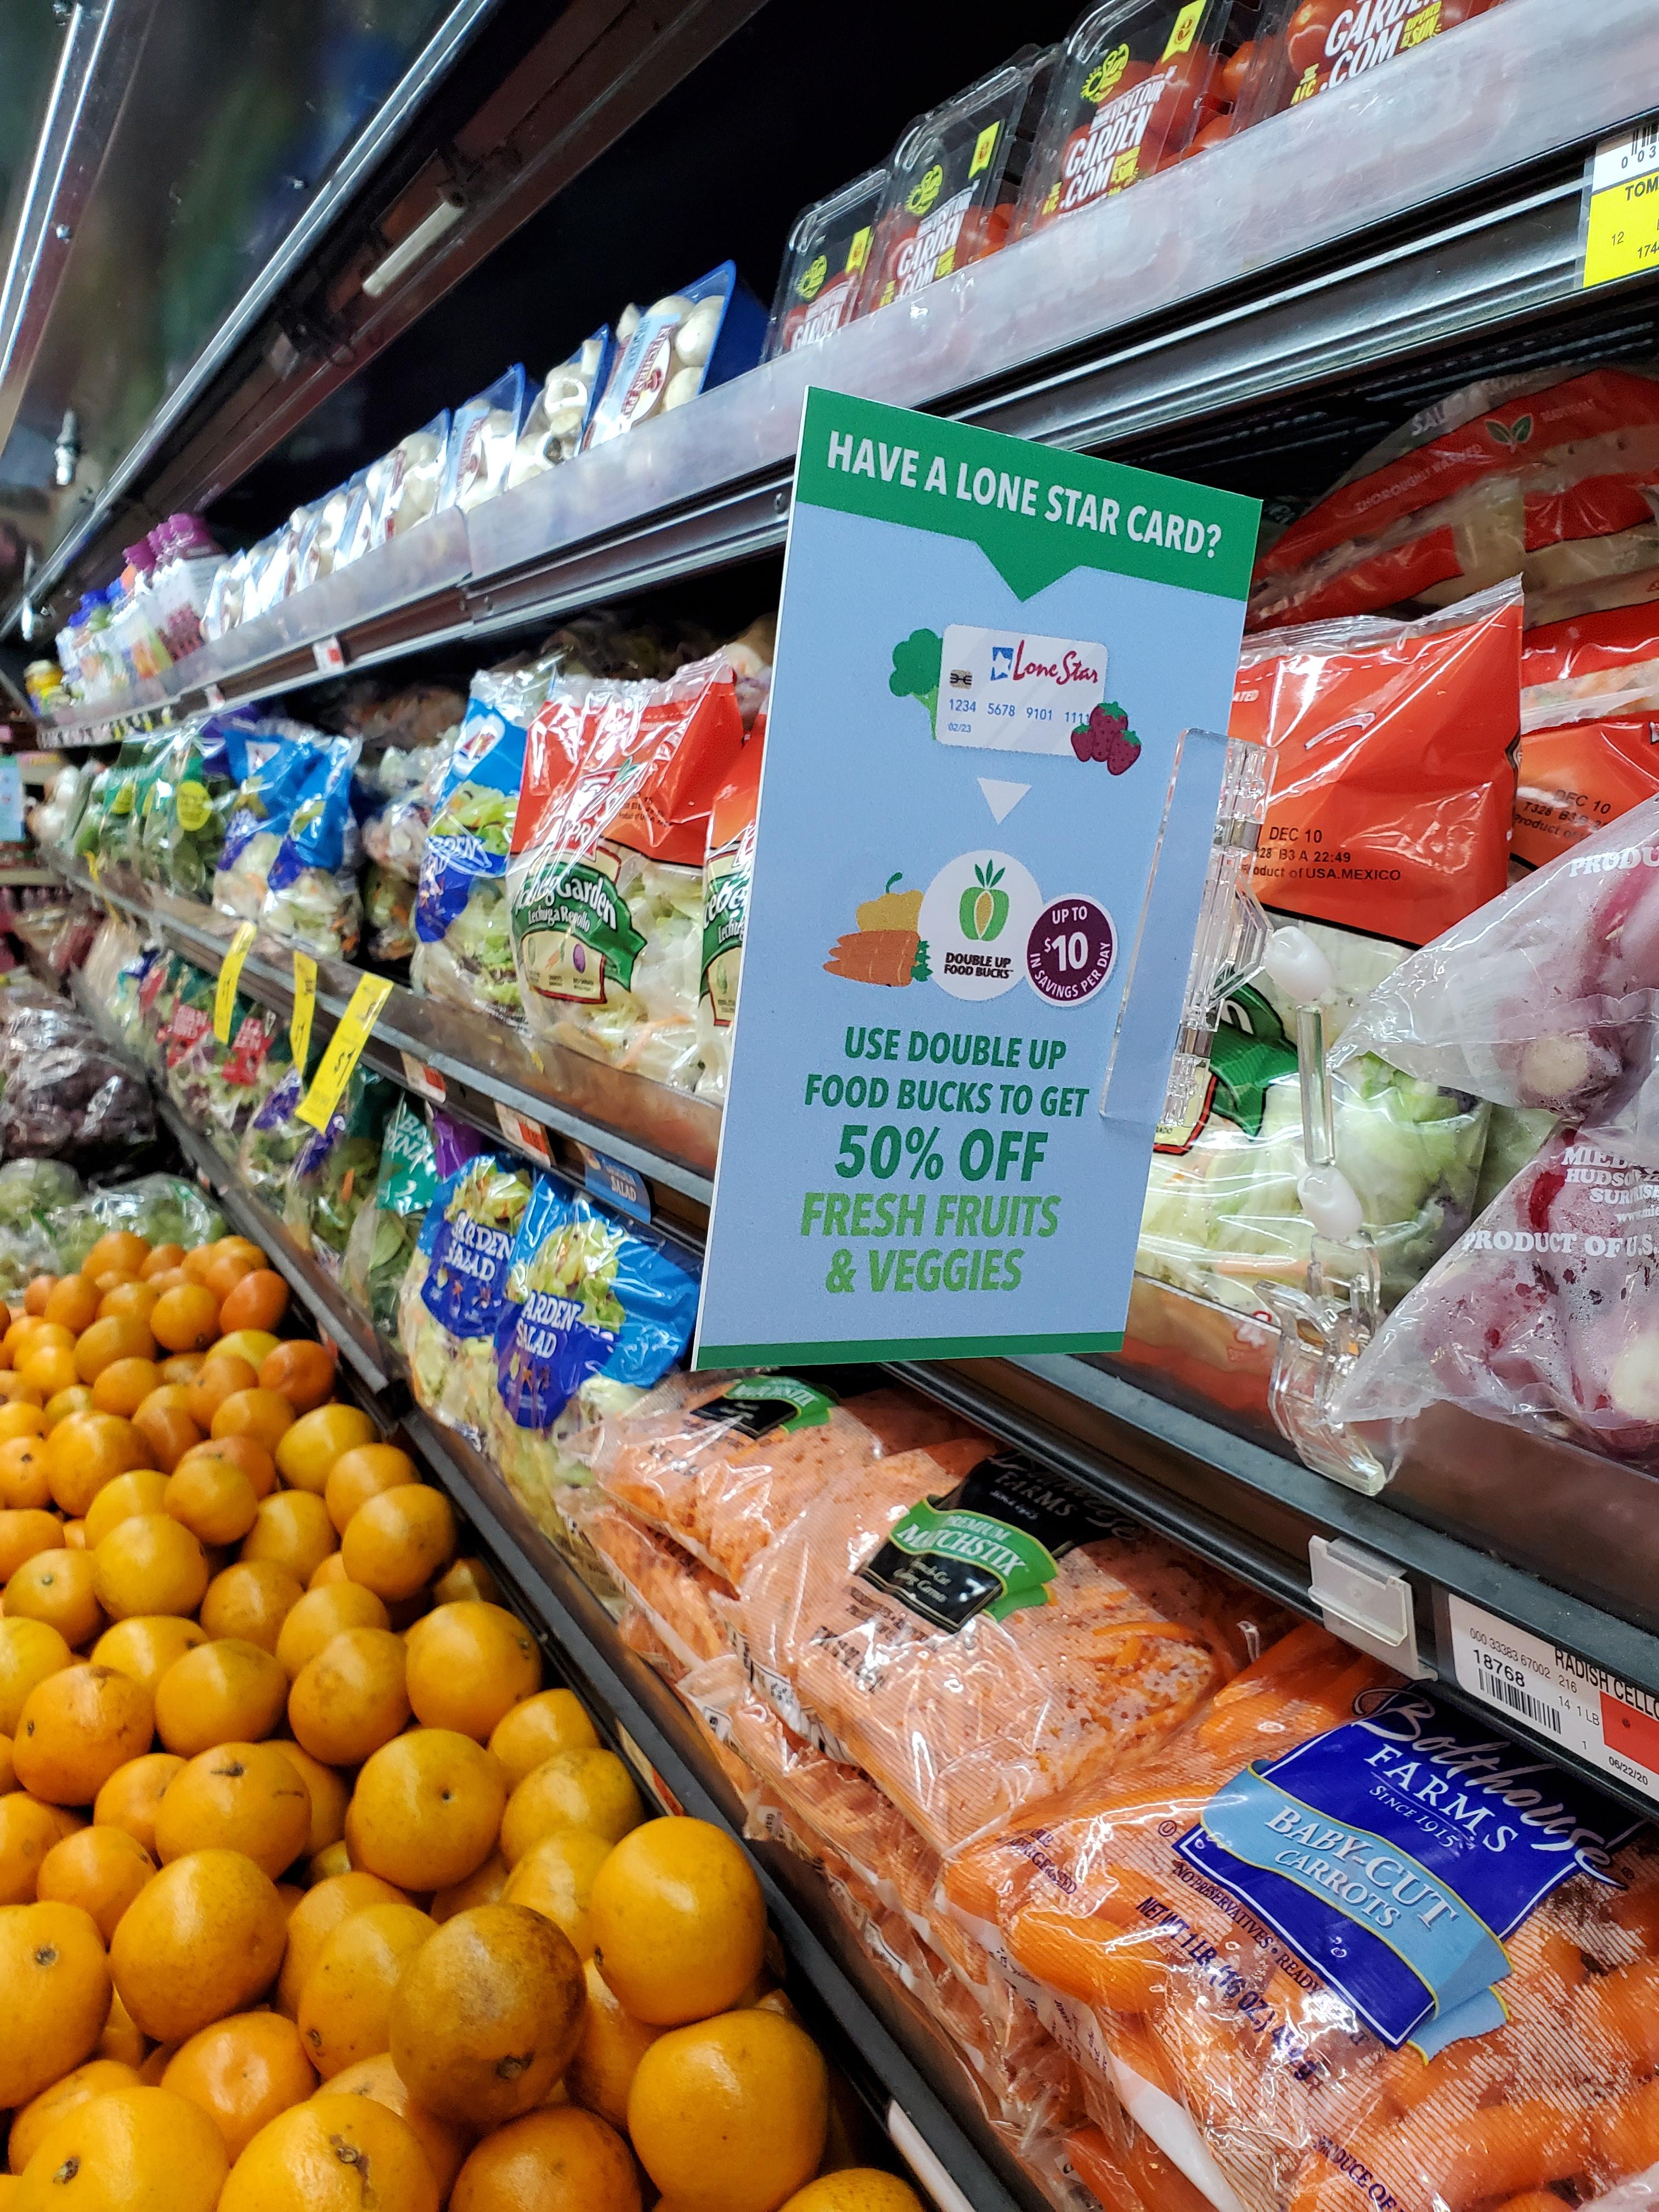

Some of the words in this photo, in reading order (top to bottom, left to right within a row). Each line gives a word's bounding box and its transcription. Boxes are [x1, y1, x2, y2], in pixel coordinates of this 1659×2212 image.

[1324, 0, 1438, 57] GARD
[1065, 103, 1155, 178] GARDEN
[1624, 177, 1659, 201] TOM
[1611, 231, 1624, 246] 12
[1637, 241, 1659, 259] 174
[827, 430, 919, 489] HAVE
[924, 456, 947, 496] A
[956, 462, 1040, 517] LONE
[1045, 484, 1121, 536] STAR
[1126, 505, 1222, 558] CARD?
[948, 723, 972, 733] 02/23
[949, 698, 977, 713] 1234
[988, 703, 1015, 717] 5678
[1026, 707, 1053, 721] 9101
[1593, 800, 1612, 815] 10
[1269, 826, 1299, 842] DEC
[1305, 829, 1323, 844] 10
[1255, 847, 1272, 859] 328
[1279, 848, 1295, 861] B3
[1299, 849, 1308, 862] A
[1313, 851, 1351, 864] 22:49
[1289, 866, 1303, 879] of
[528, 904, 560, 927] Lechuga
[557, 877, 617, 930] Garden
[1052, 909, 1069, 924] UP
[1071, 906, 1088, 921] TO
[944, 964, 973, 975] FOOD
[975, 967, 1010, 979] BUCKS
[945, 952, 992, 968] DOUBLE
[995, 956, 1011, 969] UP
[1030, 953, 1042, 968] IN
[1044, 932, 1088, 972] $10
[1097, 942, 1110, 968] DAY
[1035, 970, 1079, 998] SAVINGS
[1080, 969, 1102, 992] PER
[845, 1026, 900, 1060] USE
[907, 1031, 1022, 1068] DOUBLE
[1028, 1039, 1066, 1070] UP
[804, 1074, 889, 1109] FOOD
[896, 1079, 994, 1114] BUCKS
[999, 1084, 1032, 1115] TO
[1040, 1086, 1090, 1117] GET
[834, 1124, 944, 1181] 50%
[960, 1128, 1049, 1181] OFF
[1561, 1146, 1629, 1169] MIED
[800, 1192, 927, 1237] FRESH
[935, 1194, 1062, 1237] FRUITS
[1460, 1230, 1577, 1254] PRODUCT
[1584, 1235, 1623, 1259] OF
[825, 1248, 856, 1294] &
[868, 1248, 1025, 1293] VEGGIES
[522, 1291, 581, 1332] ARDEN
[994, 1470, 1079, 1517] FARMS
[1470, 1627, 1487, 1645] 000
[1489, 1637, 1519, 1662] 33383
[1520, 1654, 1551, 1679] 67002
[1558, 1675, 1577, 1694] 216
[1473, 1649, 1525, 1688] 18768
[1554, 1647, 1609, 1692] RADISH
[1558, 1695, 1571, 1711] 14
[1577, 1705, 1582, 1717] 1
[1585, 1708, 1600, 1726] LB
[1351, 1687, 1628, 1889] Bolthouse
[1608, 1756, 1649, 1786] 06/22/20
[1364, 1743, 1519, 1852] FARMS
[1369, 1785, 1417, 1817] SINCE
[1415, 1814, 1462, 1849] 1915
[1265, 1805, 1459, 1931] BABY-CUT
[1274, 1849, 1401, 1928] CARROTS
[1136, 1896, 1164, 1920] NET
[1181, 1933, 1194, 1949] 1
[1191, 1879, 1274, 1950] PRESERVATIVES
[1275, 1953, 1323, 1996] READY
[1312, 2135, 1374, 2188] PRODUCE
[1368, 2183, 1398, 2212] OF
